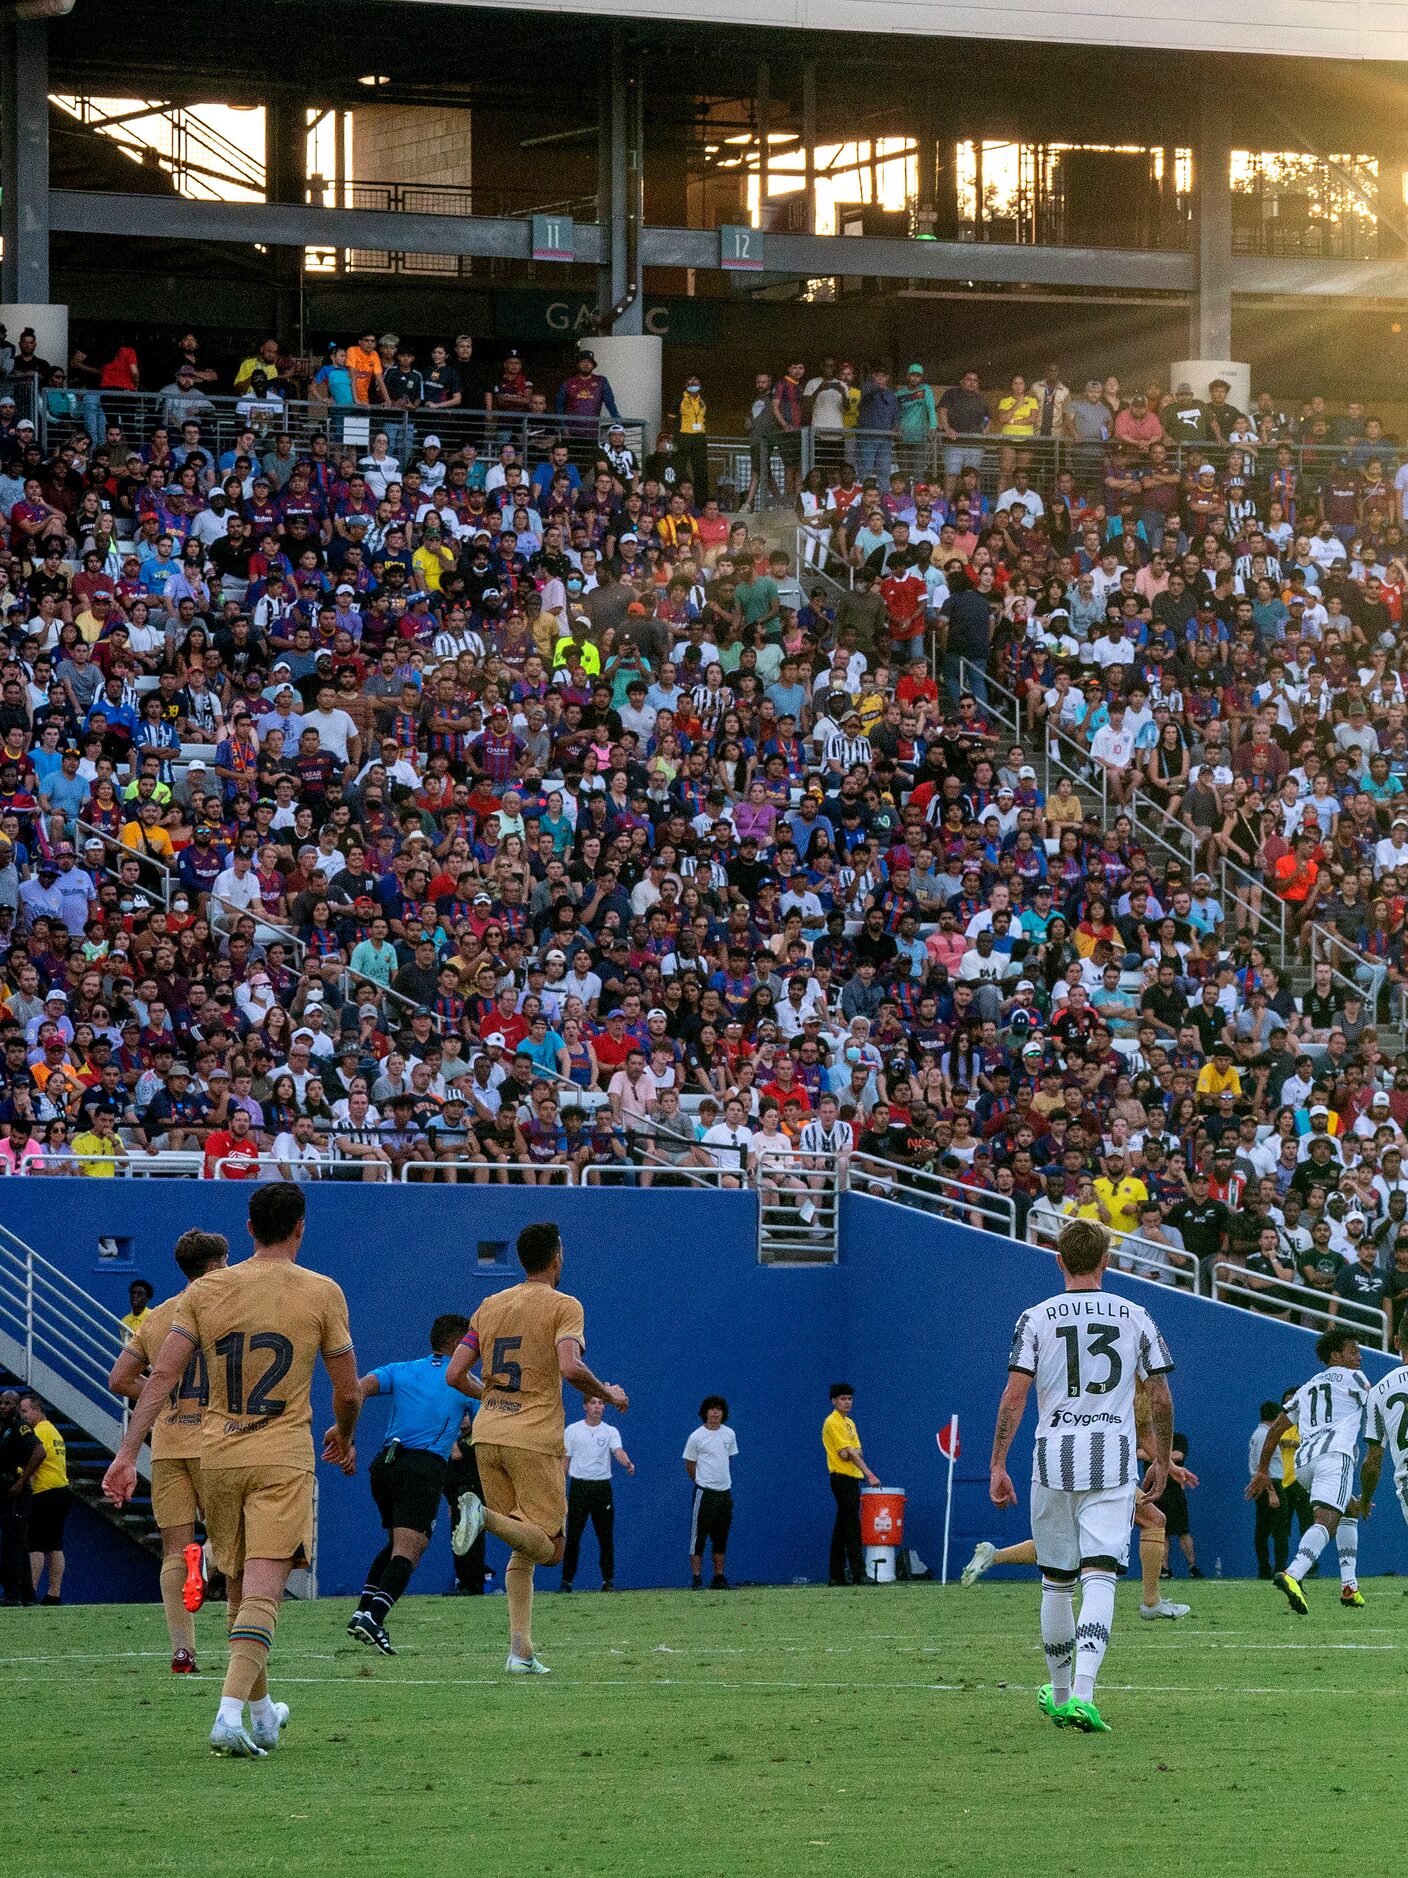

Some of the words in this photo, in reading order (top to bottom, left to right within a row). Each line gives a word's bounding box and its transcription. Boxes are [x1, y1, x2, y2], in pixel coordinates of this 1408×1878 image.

[547, 224, 560, 249] 11
[735, 234, 751, 259] 12
[1112, 744, 1122, 755] 10
[1354, 1274, 1382, 1285] Reebok
[1046, 1302, 1130, 1320] ROVELLA
[490, 1335, 523, 1393] 5
[1055, 1323, 1122, 1398] 13
[215, 1331, 294, 1416] 12
[1378, 1380, 1390, 1396] DI
[1307, 1382, 1333, 1427] 11
[1061, 1411, 1122, 1426] Cygames
